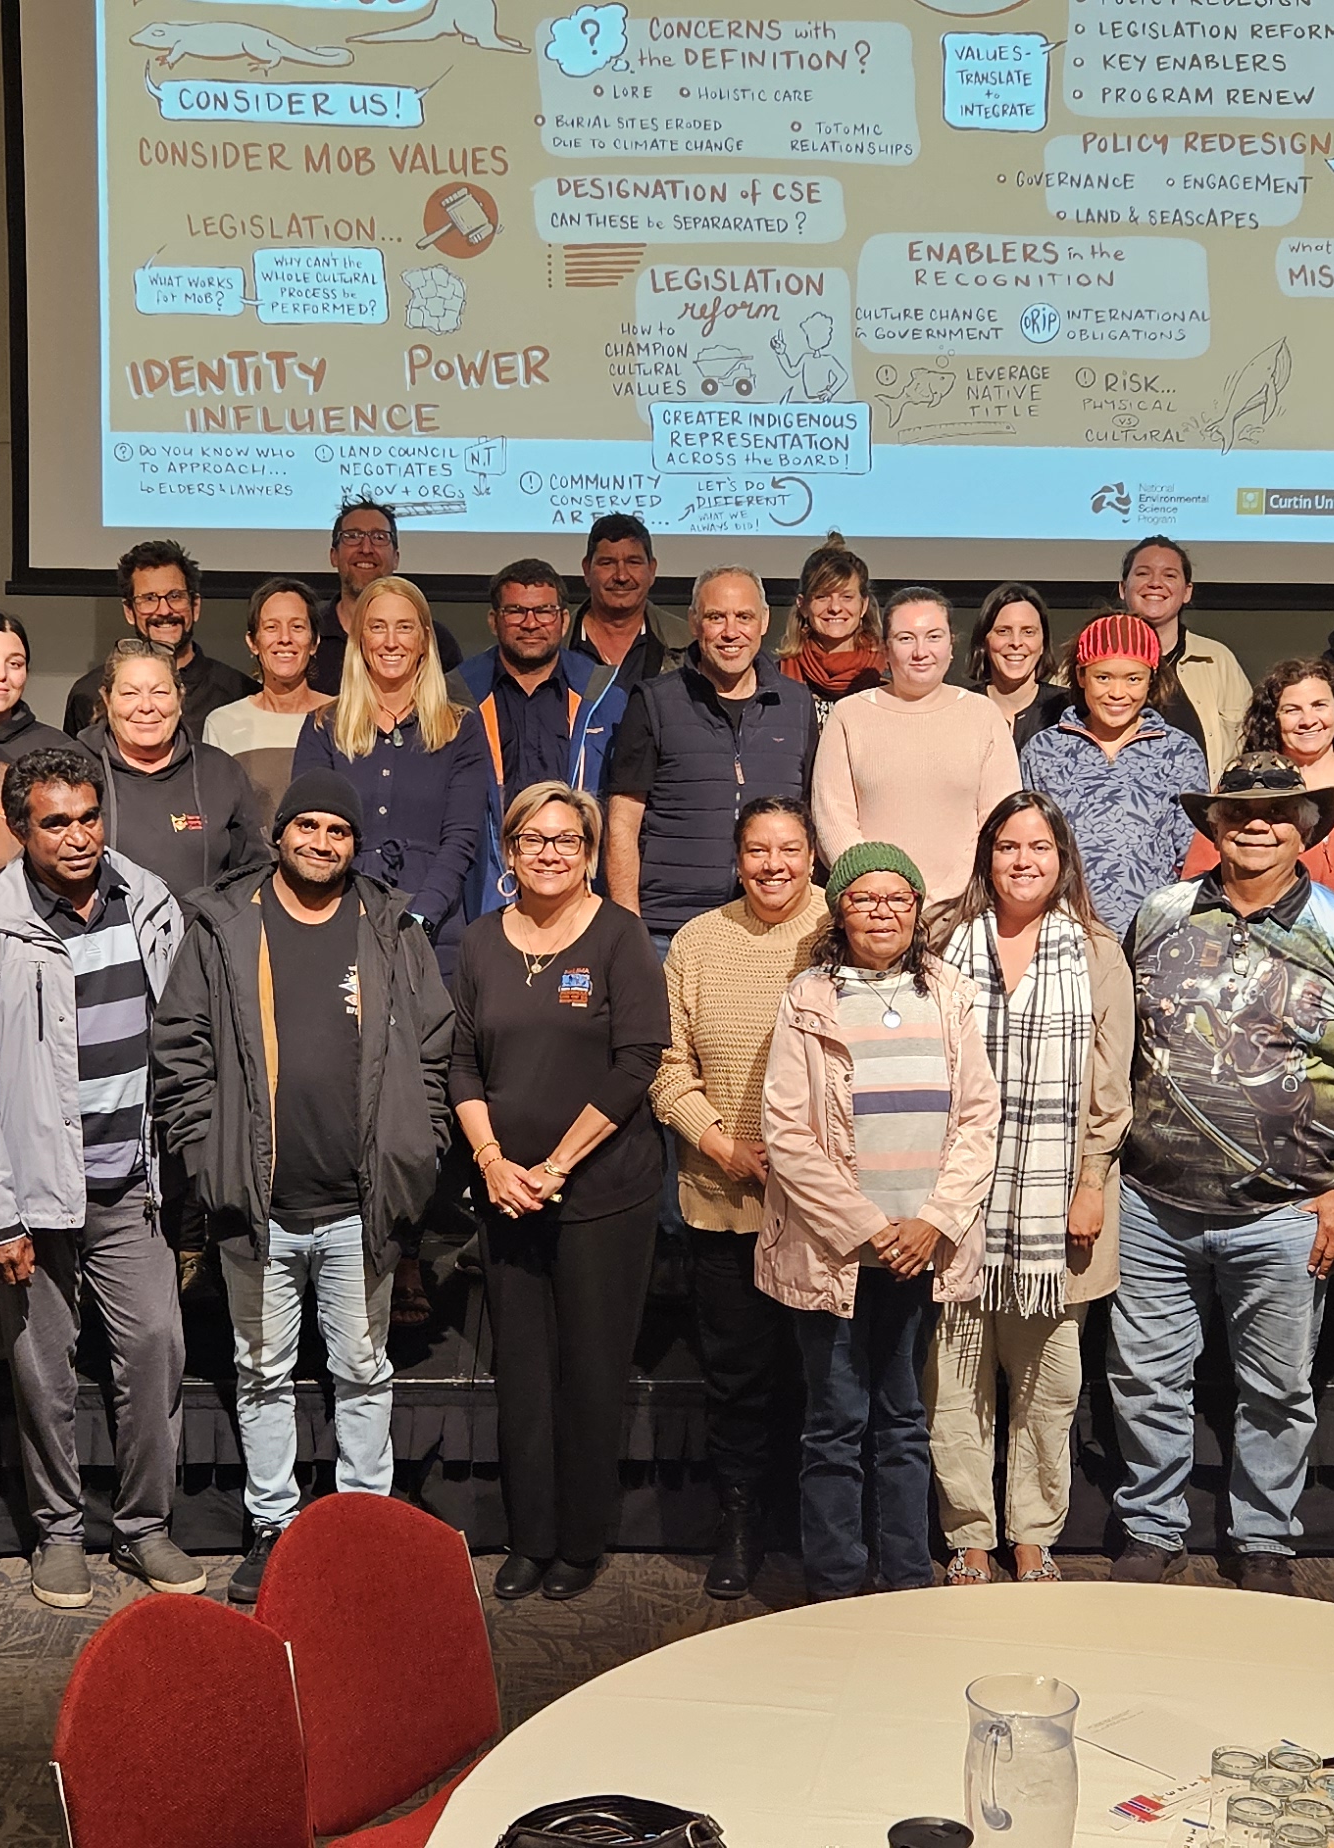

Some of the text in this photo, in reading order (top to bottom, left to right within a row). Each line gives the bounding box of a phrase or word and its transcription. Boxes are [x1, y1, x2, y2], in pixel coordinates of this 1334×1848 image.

[650, 17, 836, 41] CONCERNS with
[1099, 21, 1237, 40] LEGISLATION
[638, 48, 675, 67] the
[1102, 53, 1287, 72] KEY ENABLERS
[956, 70, 1032, 86] TRANSLATE
[613, 84, 653, 100] LORE
[698, 86, 813, 102] HOLISTIC CARE
[985, 89, 1000, 99] to
[1102, 86, 1315, 105] PROGRAM RENEW
[178, 87, 337, 115] CONSIDER
[960, 103, 1035, 119] INTEGRATE
[555, 115, 722, 131] BURIAL SITES ERODED
[553, 137, 581, 150] DUE
[613, 137, 679, 152] CLIMATE
[685, 138, 744, 152] CHANGE
[791, 139, 913, 157] RELATIONSHIPS
[1083, 132, 1331, 156] POLICY REDESIGN
[138, 137, 509, 177] CONSIDER MOB VALUES
[1017, 172, 1135, 190] GOVERNANCE
[1183, 174, 1313, 194] ENGAGEMENT
[557, 177, 823, 206] DESIGNATION of CSE
[551, 212, 580, 229] CAN
[585, 214, 639, 230] THESE
[647, 215, 665, 230] be
[1076, 208, 1120, 223] LAND
[1148, 208, 1259, 230] SEASCAPES
[274, 252, 363, 268] WHY CAN'T the
[908, 241, 1126, 265] ENABLERS in the
[149, 275, 233, 289] WHAT WORKS
[261, 270, 378, 285] WHOLE CULTURAL
[650, 267, 824, 297] LEGISLATION
[915, 269, 1114, 287] RECOGNITION
[156, 292, 175, 305] for
[280, 287, 357, 299] PROCESS be
[271, 300, 376, 316] PERFORMED?
[855, 306, 998, 322] CULTURE CHANGE
[1067, 308, 1210, 322] INTERNATIONAL
[678, 297, 779, 338] reform
[875, 327, 1003, 341] GOVERNMENT
[1067, 329, 1186, 341] OBLIGATIONS
[605, 343, 687, 359] CHAMPION
[126, 351, 327, 399] IDENTITY
[406, 344, 551, 390] POWER
[609, 363, 682, 377] CULTURAL
[967, 365, 1050, 382] LEVERAGE
[613, 382, 687, 397] VALUES
[967, 384, 1042, 401] NATIVE
[969, 404, 1040, 418] TITLE
[1083, 399, 1177, 412] PHYSICAL
[186, 403, 441, 434] INFLUENCE
[748, 412, 858, 431] INDIGENOUS
[670, 431, 850, 452] REPRESENTATION
[1085, 428, 1185, 443] CULTURAL
[139, 445, 295, 458] DO YOU KNOW WHO
[340, 446, 460, 459] LAND COUNCIL
[666, 452, 736, 467] ACROSS
[745, 453, 773, 467] the
[140, 462, 158, 473] TO
[340, 463, 452, 477] NEGOTIATES
[159, 483, 215, 496] ELDERS
[230, 484, 293, 496] LAWYERS
[361, 483, 397, 496] GOV
[550, 473, 661, 490] COMMUNITY
[698, 477, 764, 492] LET'S DO
[1139, 483, 1175, 492] National
[551, 495, 661, 508] CONSERVED
[696, 494, 793, 508] DIFFERENT
[1139, 494, 1209, 503] Environmental
[1270, 495, 1311, 509] Curtin
[730, 510, 747, 519] WE
[1139, 504, 1178, 513] Science
[690, 521, 728, 532] ALWAYS
[1138, 516, 1176, 525] Program
